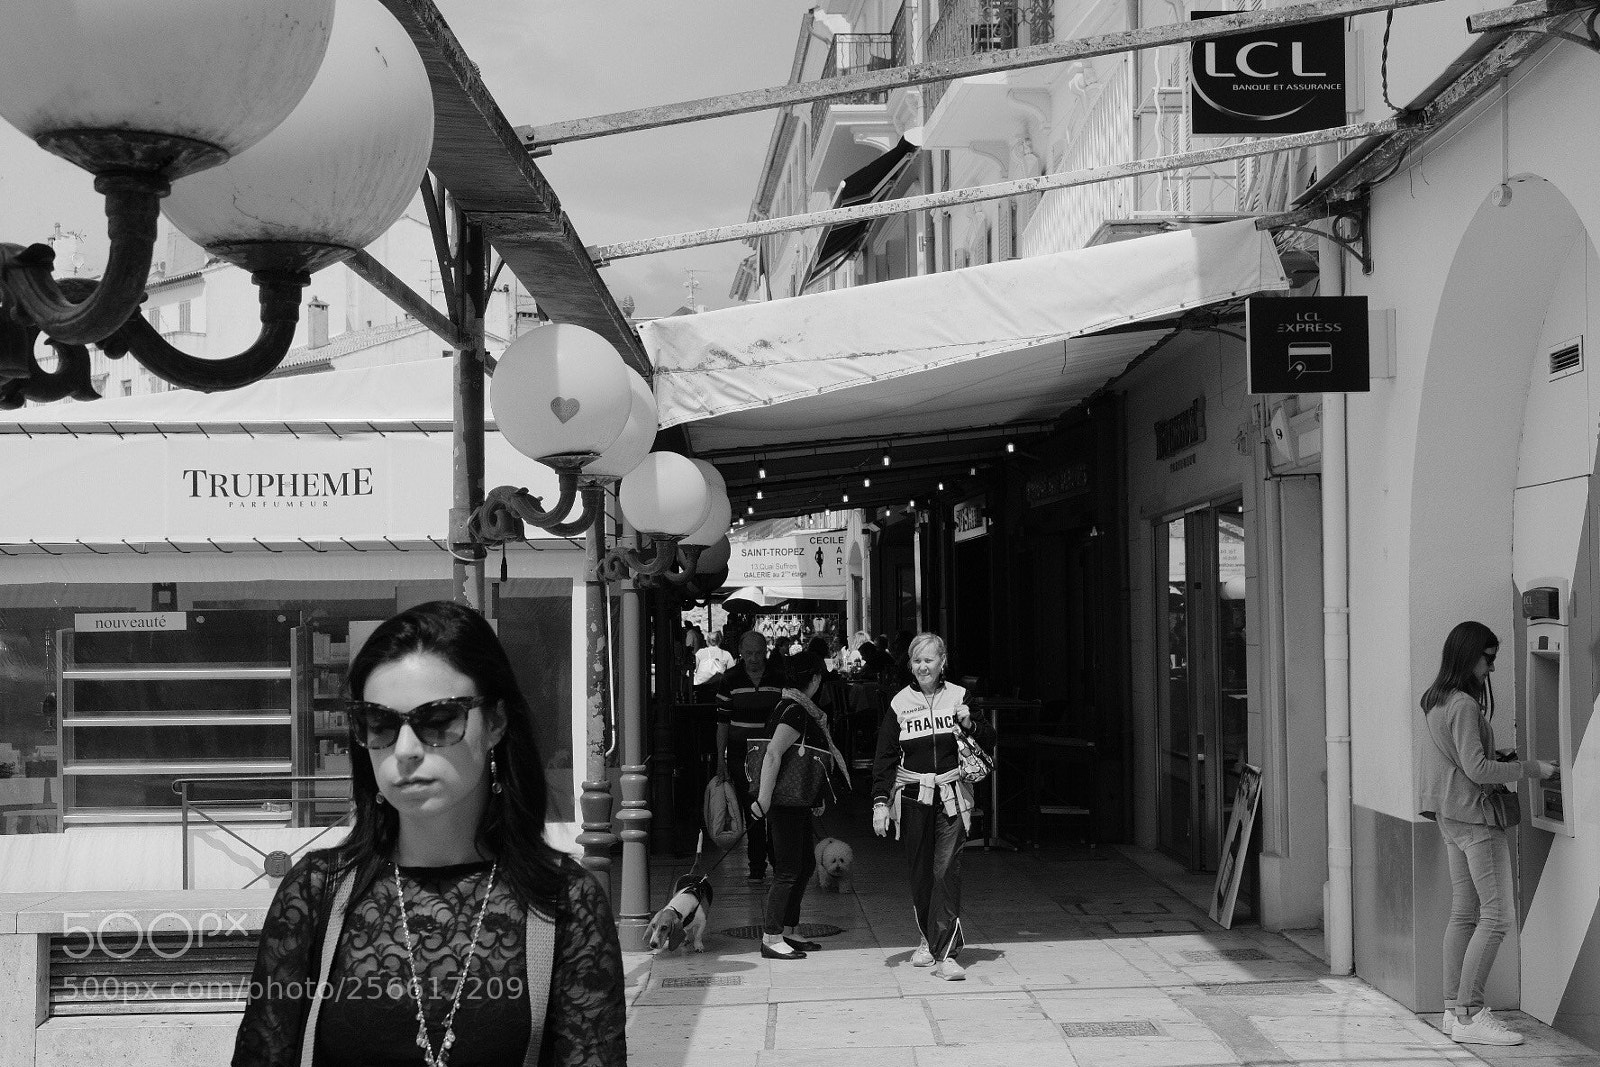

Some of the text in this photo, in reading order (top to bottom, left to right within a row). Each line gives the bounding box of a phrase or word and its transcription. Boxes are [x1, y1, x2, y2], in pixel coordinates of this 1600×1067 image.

[1205, 41, 1326, 78] LCL
[1286, 83, 1342, 91] ASSURANCE
[1296, 312, 1322, 322] LCL
[1277, 323, 1342, 333] EXPRESS
[182, 467, 373, 498] TRUPHEME
[809, 536, 844, 545] CECILE
[741, 547, 805, 557] SAINT-TROPEZ
[95, 614, 167, 630] nouveauté
